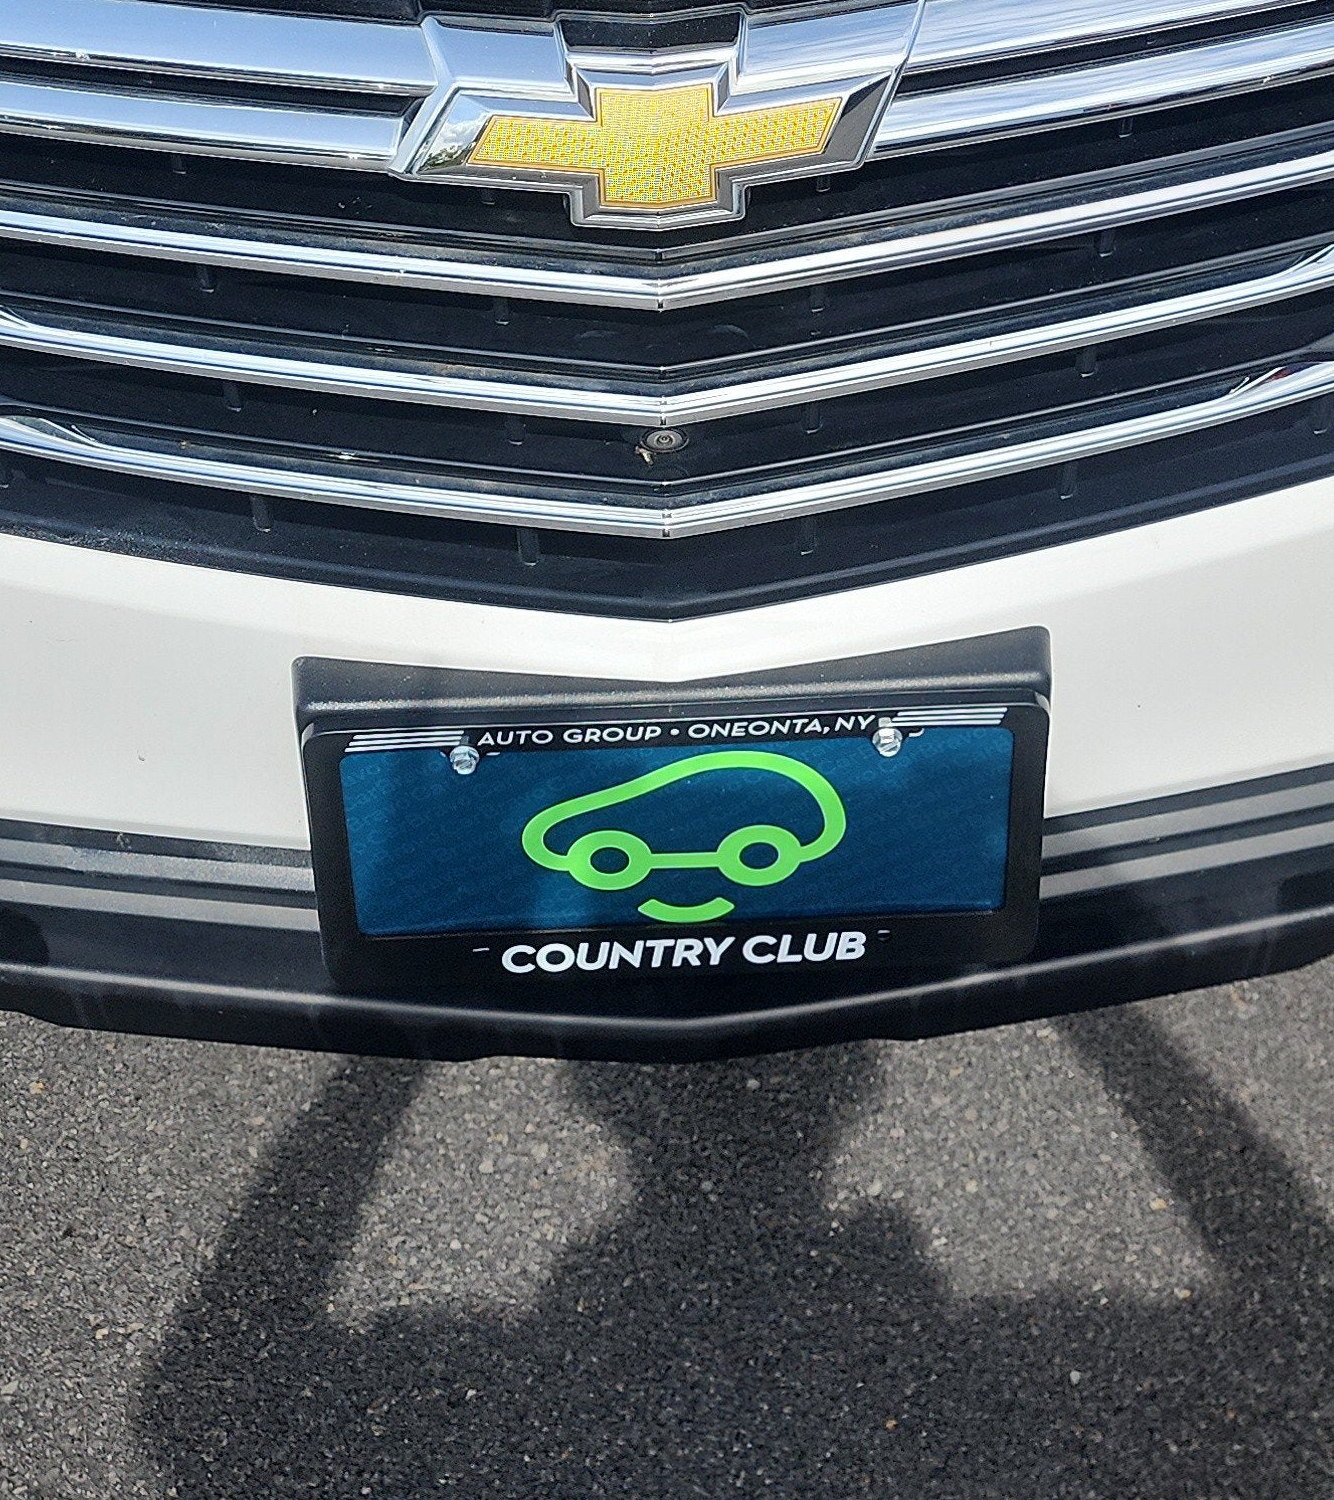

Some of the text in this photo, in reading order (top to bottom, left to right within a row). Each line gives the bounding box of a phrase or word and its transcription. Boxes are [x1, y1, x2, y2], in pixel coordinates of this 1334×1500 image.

[477, 729, 554, 746] AUTO
[563, 726, 662, 743] GROUP
[501, 931, 867, 974] COUNTRY CLUB
